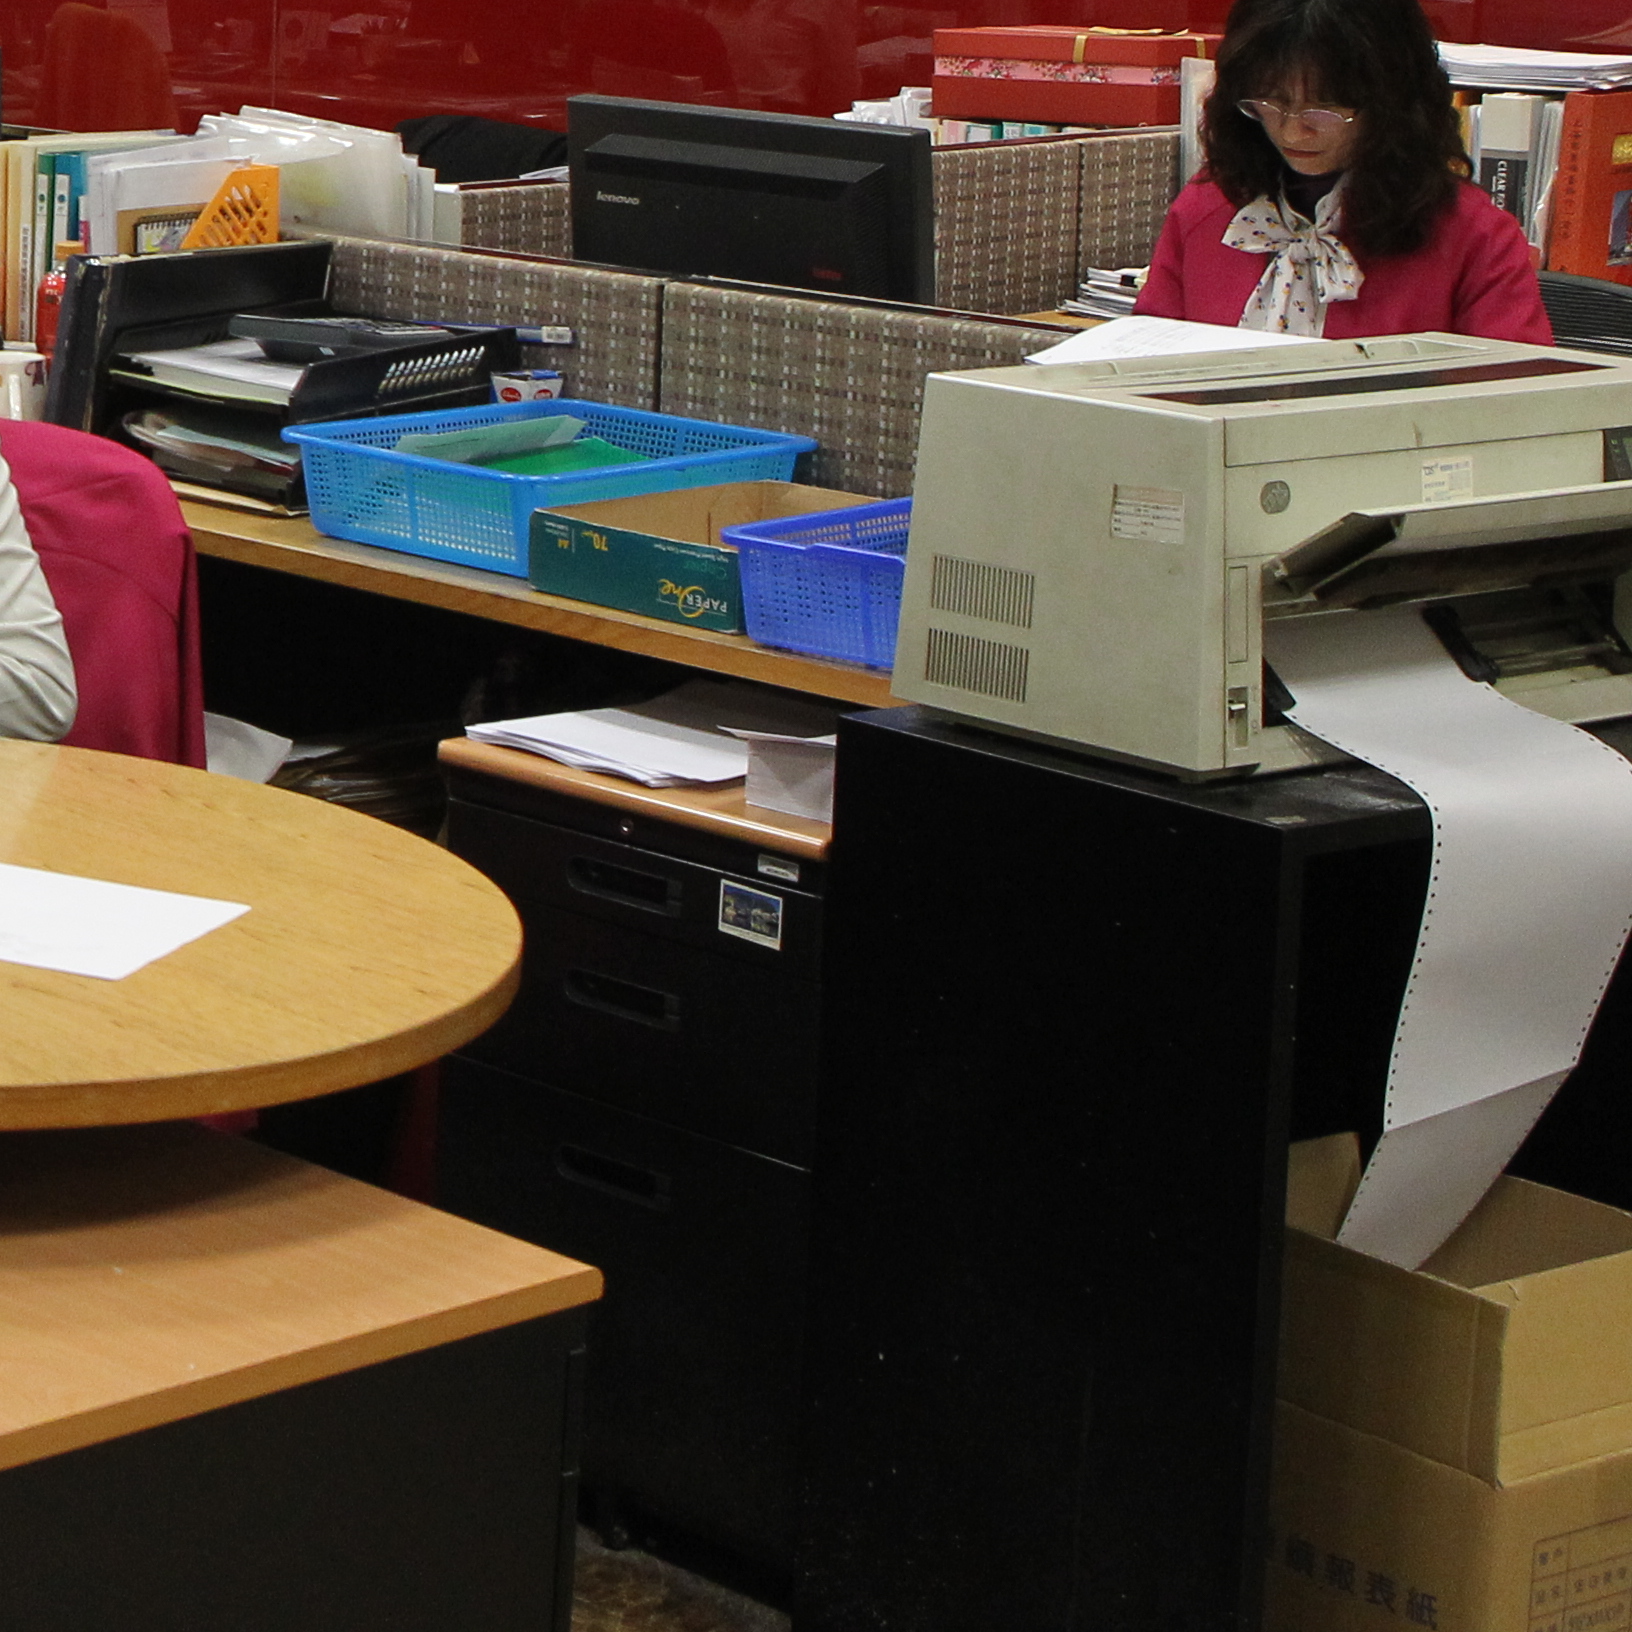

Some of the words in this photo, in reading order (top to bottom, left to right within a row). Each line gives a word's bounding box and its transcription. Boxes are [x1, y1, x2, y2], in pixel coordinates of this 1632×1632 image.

[1496, 160, 1508, 191] CLEAR
[596, 190, 640, 205] lenovo
[1495, 193, 1506, 211] BO
[592, 532, 609, 551] 70
